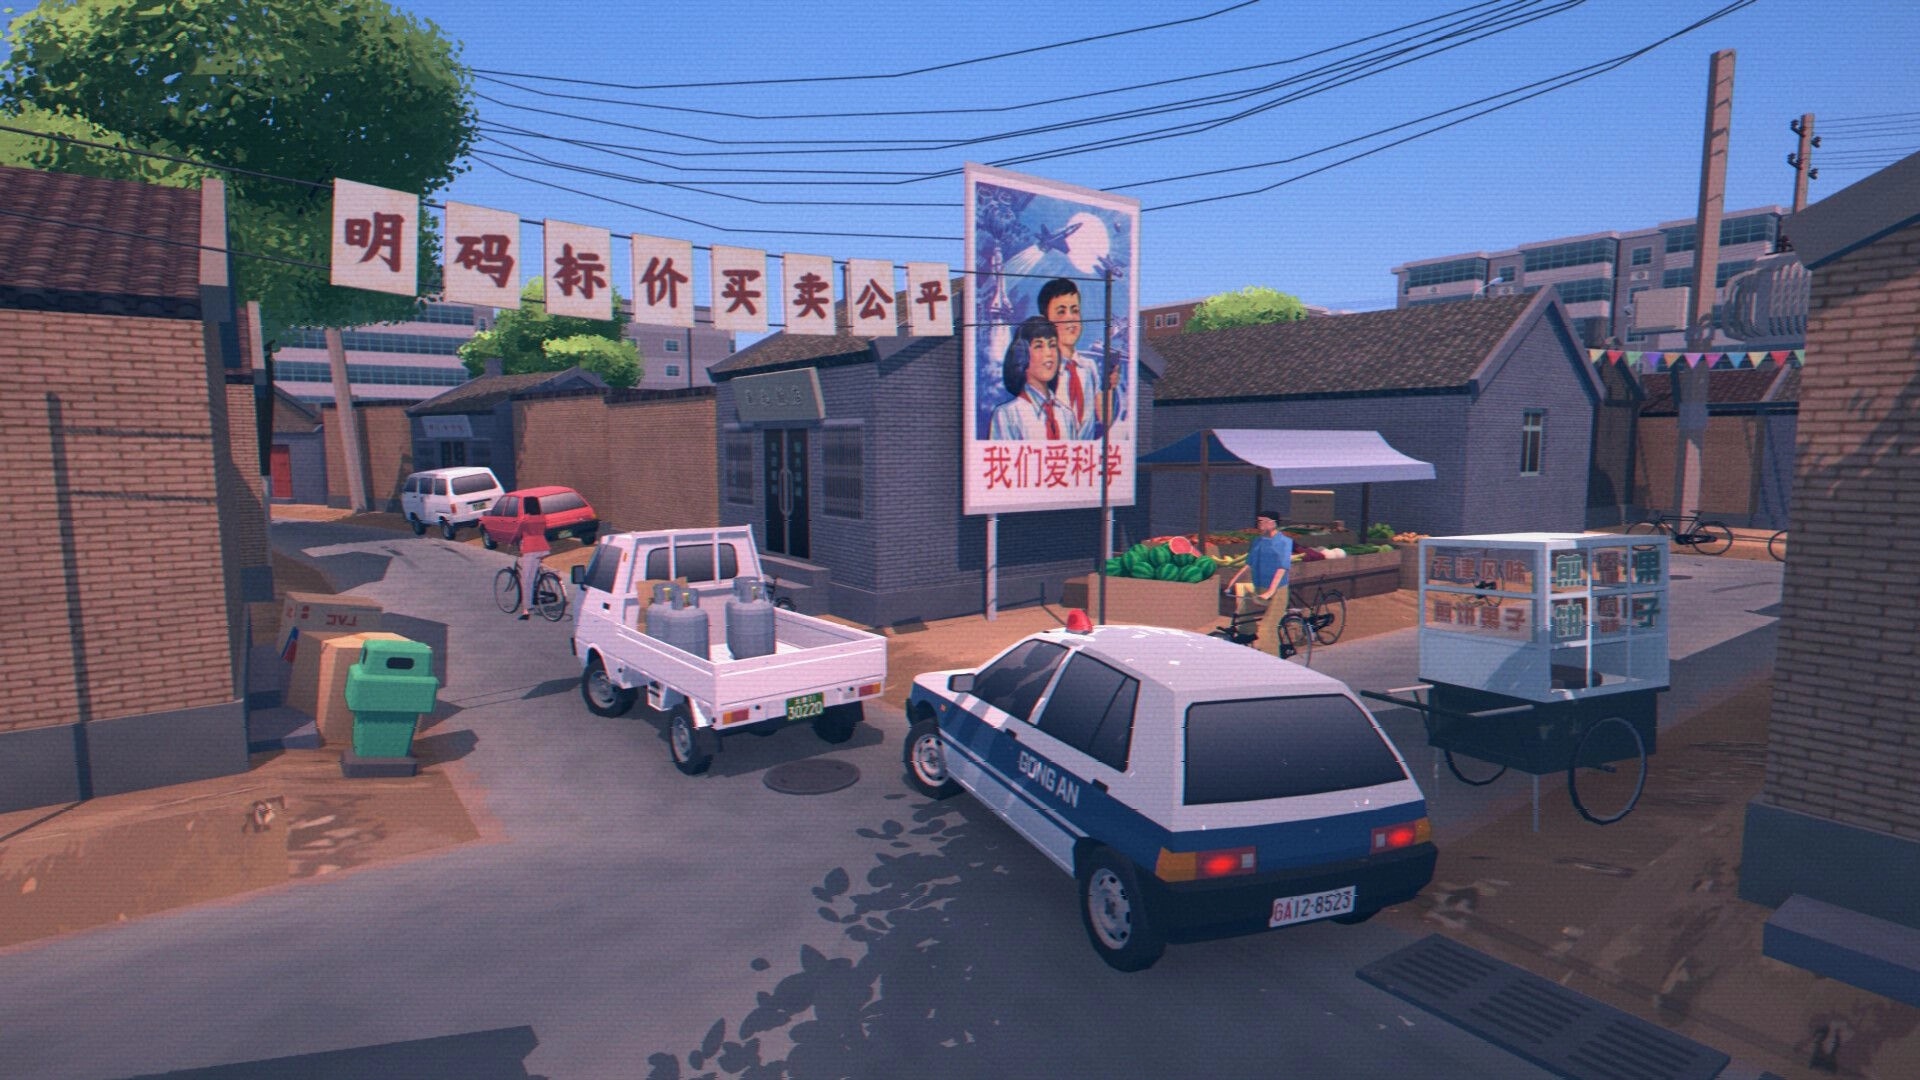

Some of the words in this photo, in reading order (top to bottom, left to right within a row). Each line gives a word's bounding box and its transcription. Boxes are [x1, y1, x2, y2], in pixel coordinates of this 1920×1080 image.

[344, 211, 949, 321] 明码标价买卖公平
[983, 444, 1122, 489] 我们爱科学
[1433, 556, 1526, 584] 天津风味
[787, 701, 823, 720] 30220
[1018, 750, 1056, 792] GONG
[1056, 775, 1080, 808] AN
